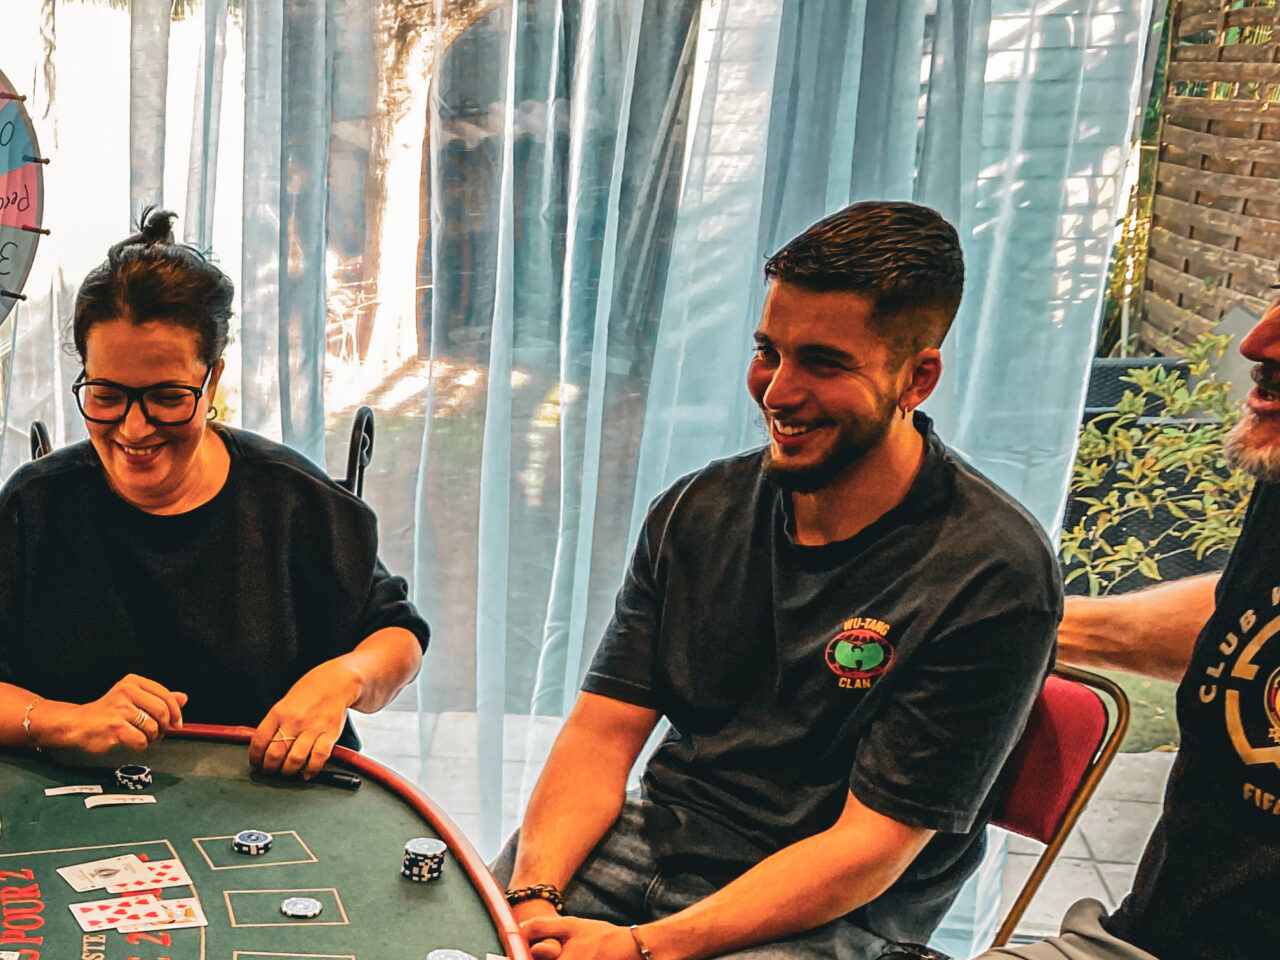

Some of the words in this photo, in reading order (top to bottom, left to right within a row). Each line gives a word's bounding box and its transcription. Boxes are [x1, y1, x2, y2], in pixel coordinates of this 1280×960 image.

[843, 617, 891, 637] WU-TANG
[1198, 608, 1257, 704] CLUB
[838, 677, 871, 689] CLAN
[0, 882, 45, 946] POUR
[125, 931, 172, 947] 2
